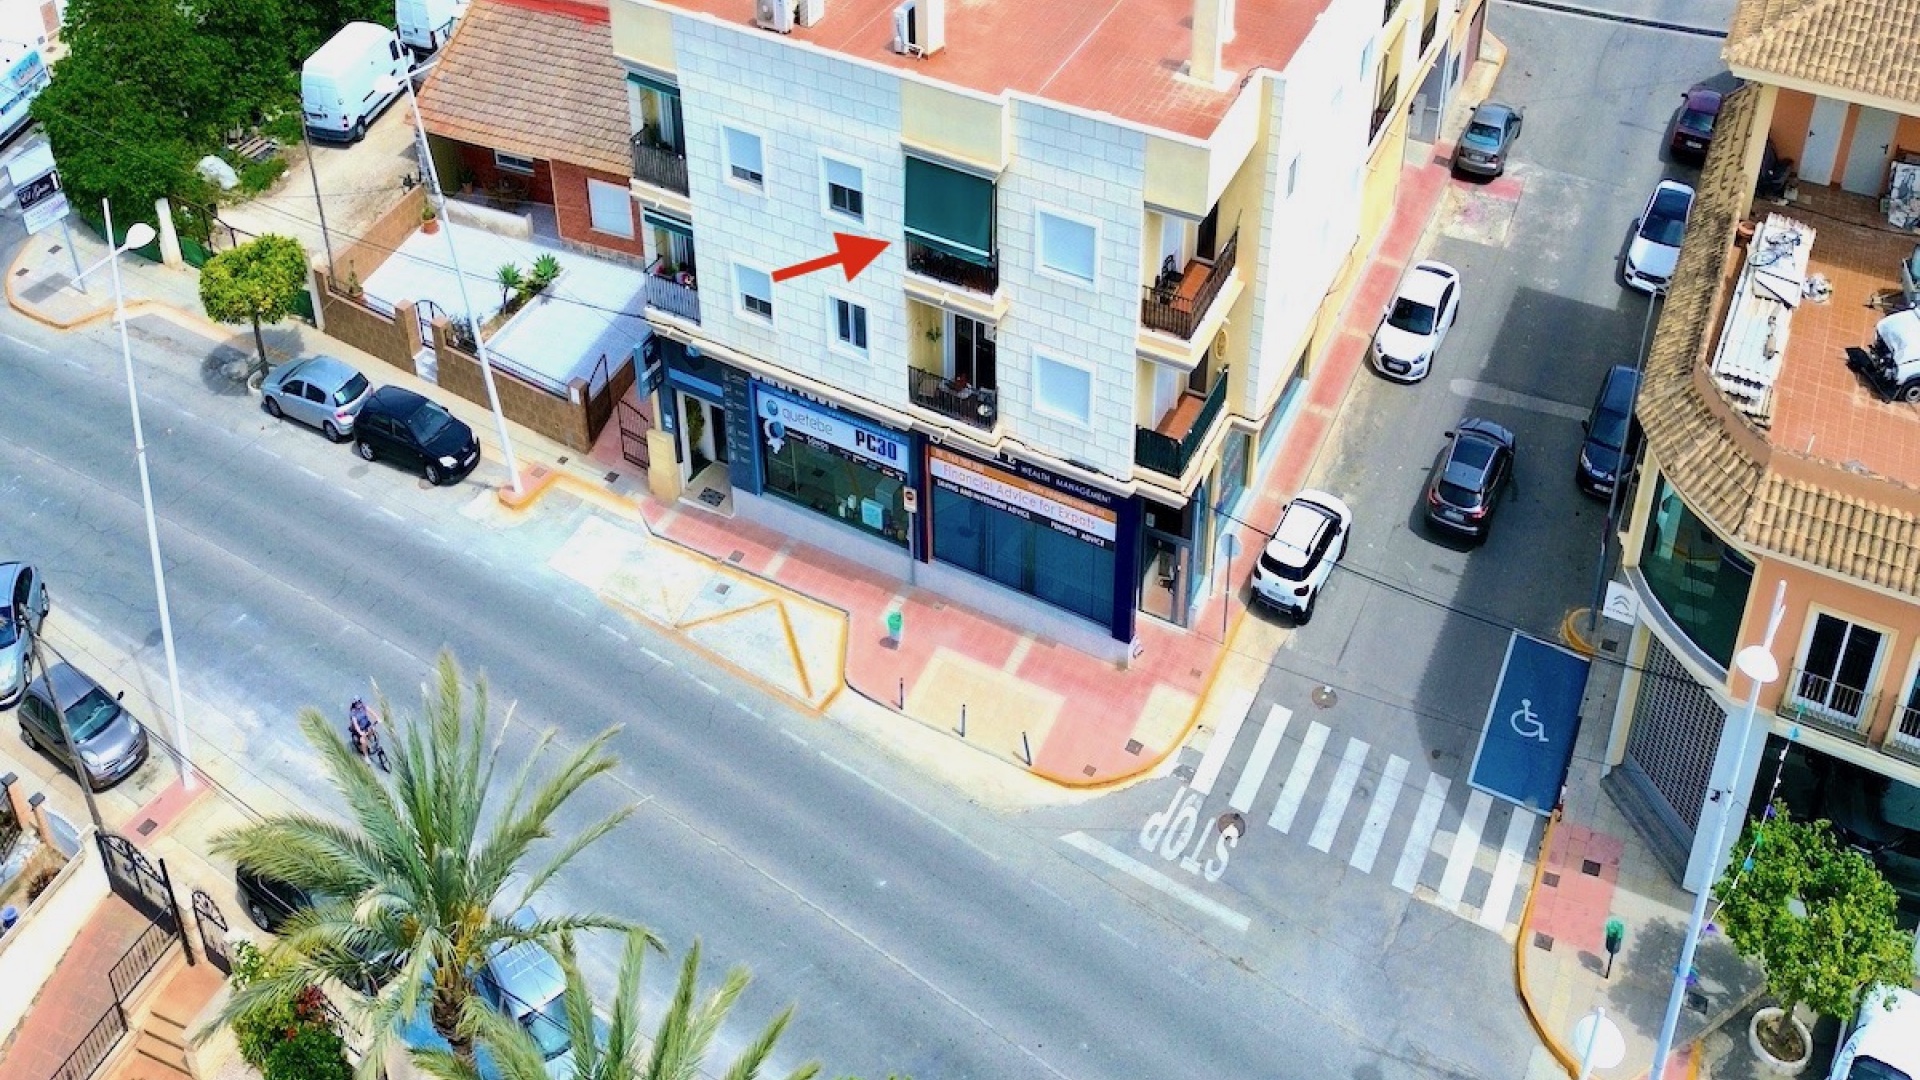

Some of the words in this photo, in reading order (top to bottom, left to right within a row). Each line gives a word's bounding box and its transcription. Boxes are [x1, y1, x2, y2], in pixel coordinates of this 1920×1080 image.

[782, 408, 833, 436] quetebe
[943, 464, 993, 491] Financial
[997, 483, 1036, 507] Advice
[1039, 502, 1054, 515] for
[1058, 506, 1096, 530] Expats
[1021, 466, 1050, 482] WEALTH
[1055, 479, 1111, 503] MANAGEMENT
[1138, 785, 1241, 883] STOP
